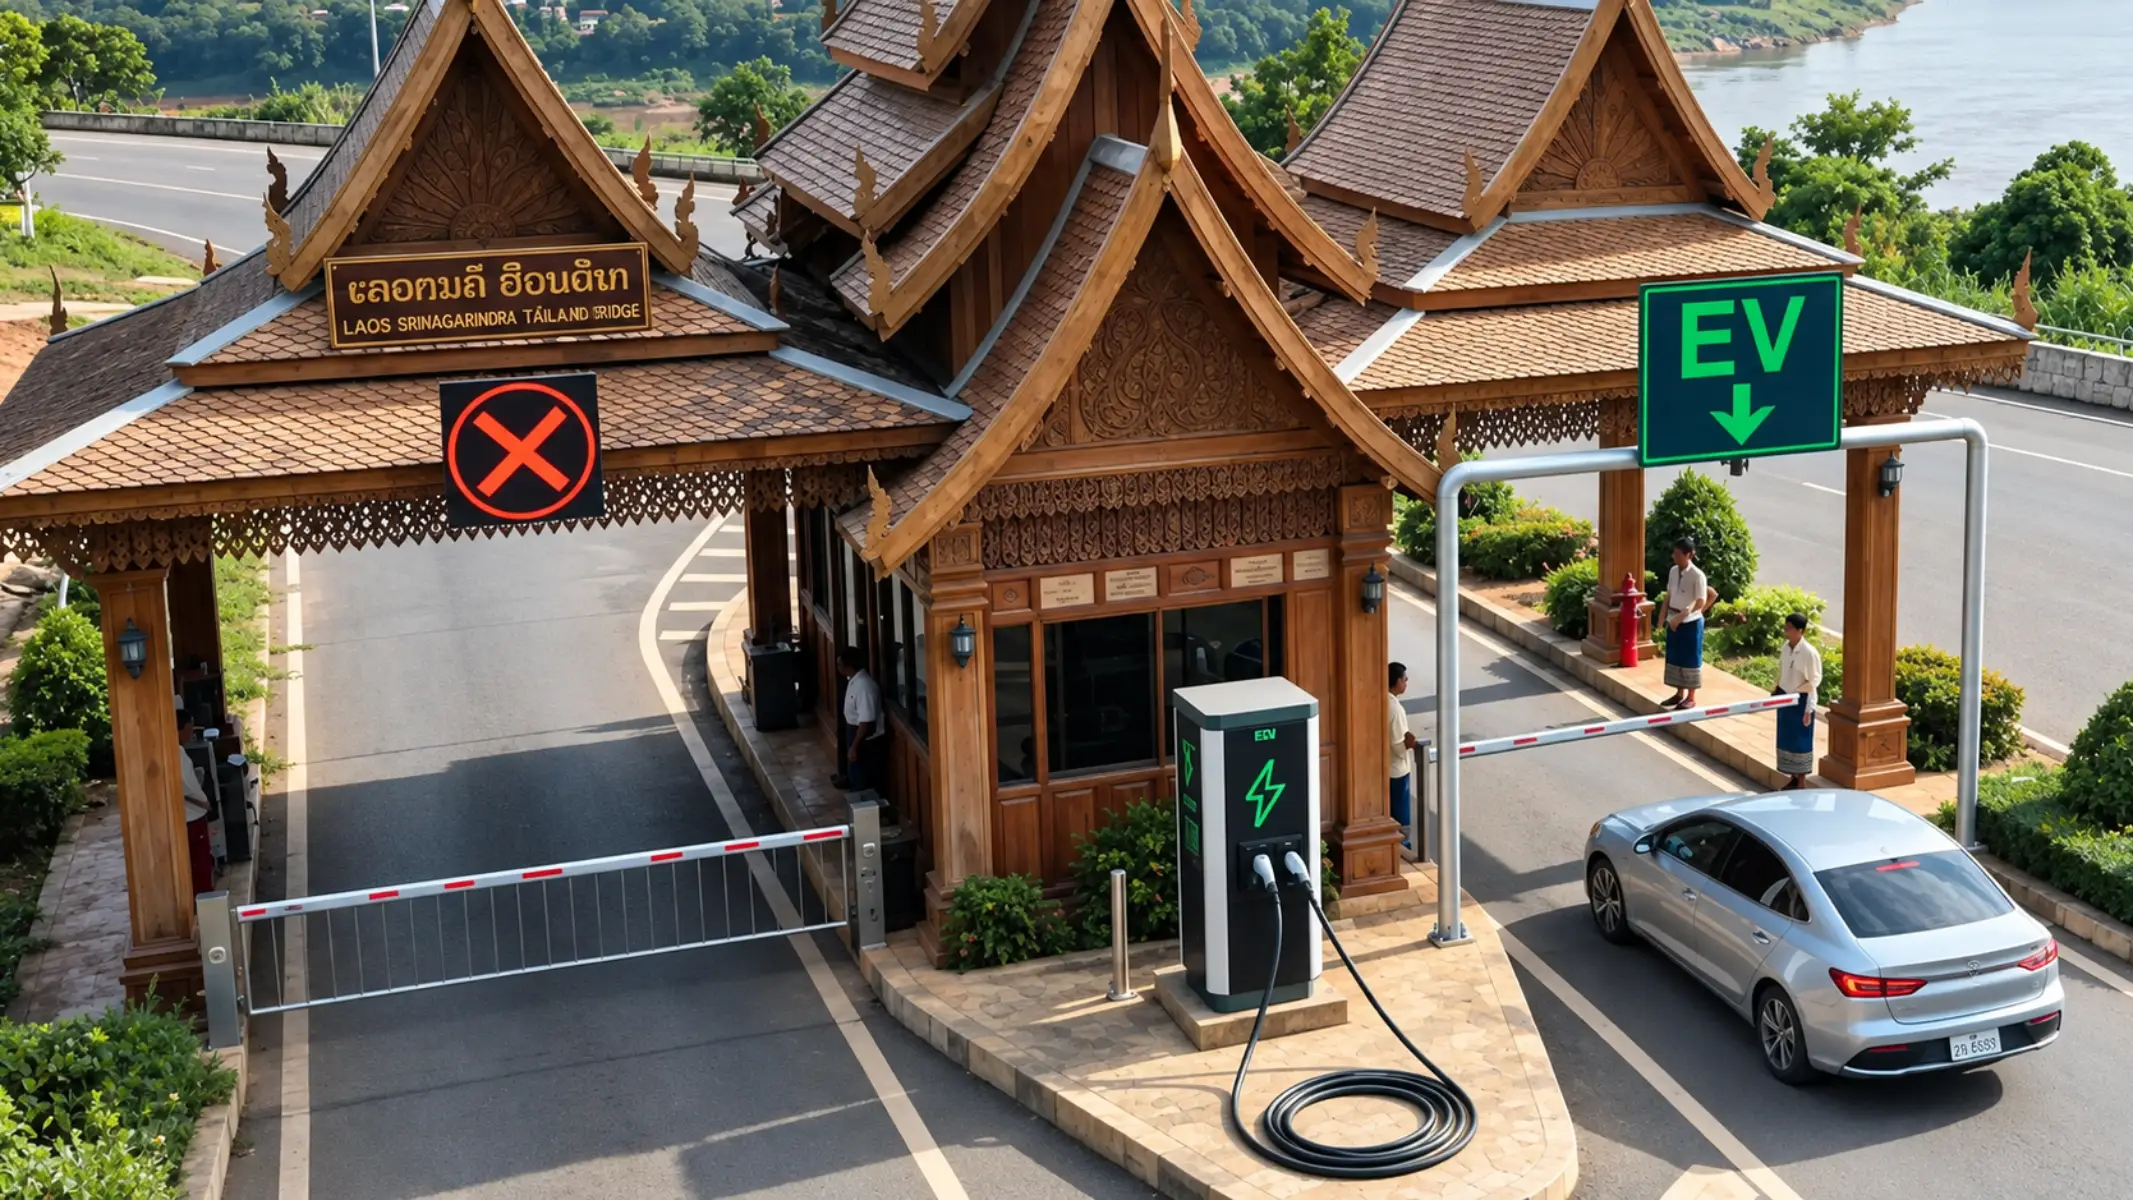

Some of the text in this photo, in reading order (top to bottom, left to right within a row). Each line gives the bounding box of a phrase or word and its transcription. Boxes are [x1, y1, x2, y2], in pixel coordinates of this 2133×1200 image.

[343, 317, 392, 336] LAOS
[397, 310, 518, 332] SRINAGARINDRA
[1681, 295, 1806, 380] EV
